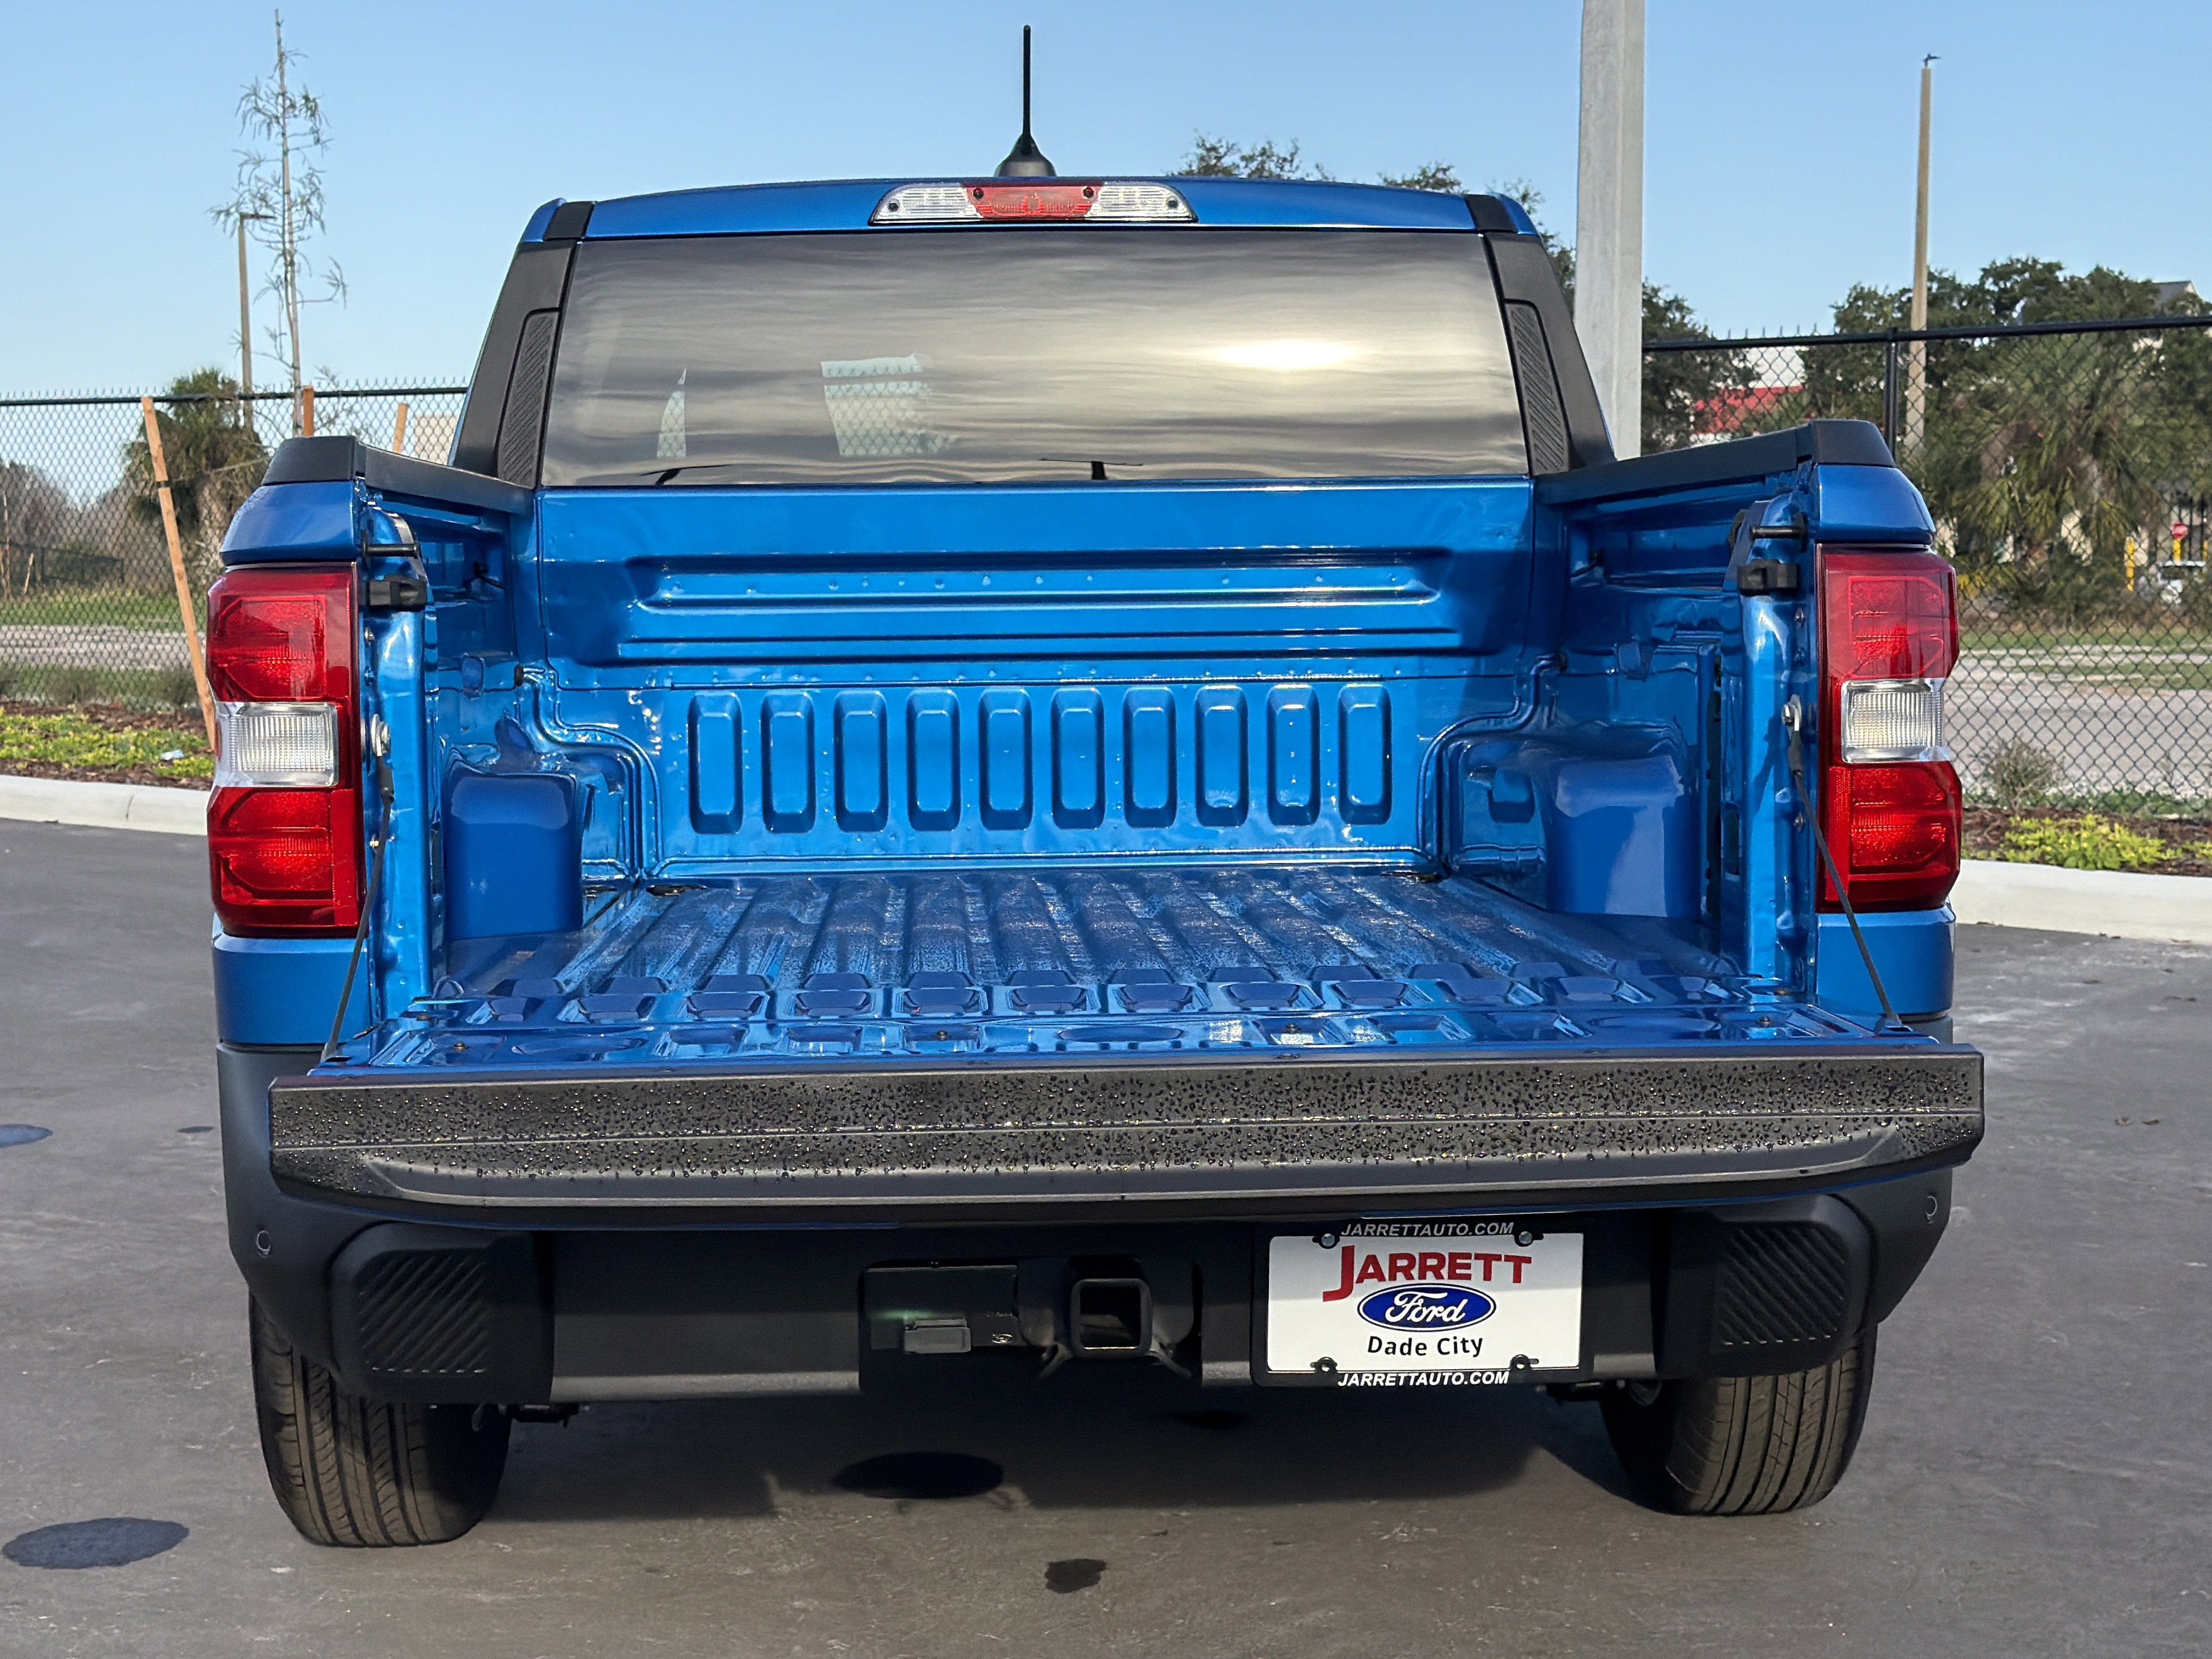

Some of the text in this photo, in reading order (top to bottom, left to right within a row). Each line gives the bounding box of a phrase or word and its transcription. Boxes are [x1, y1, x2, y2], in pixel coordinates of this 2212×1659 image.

[1341, 1222, 1514, 1237] JARRETTAUTO.COM
[1322, 1245, 1532, 1302] JARRETT
[1385, 1291, 1468, 1323] Ford
[1368, 1336, 1483, 1357] Dade City
[1338, 1372, 1510, 1387] JARRETTAUTO.COM
